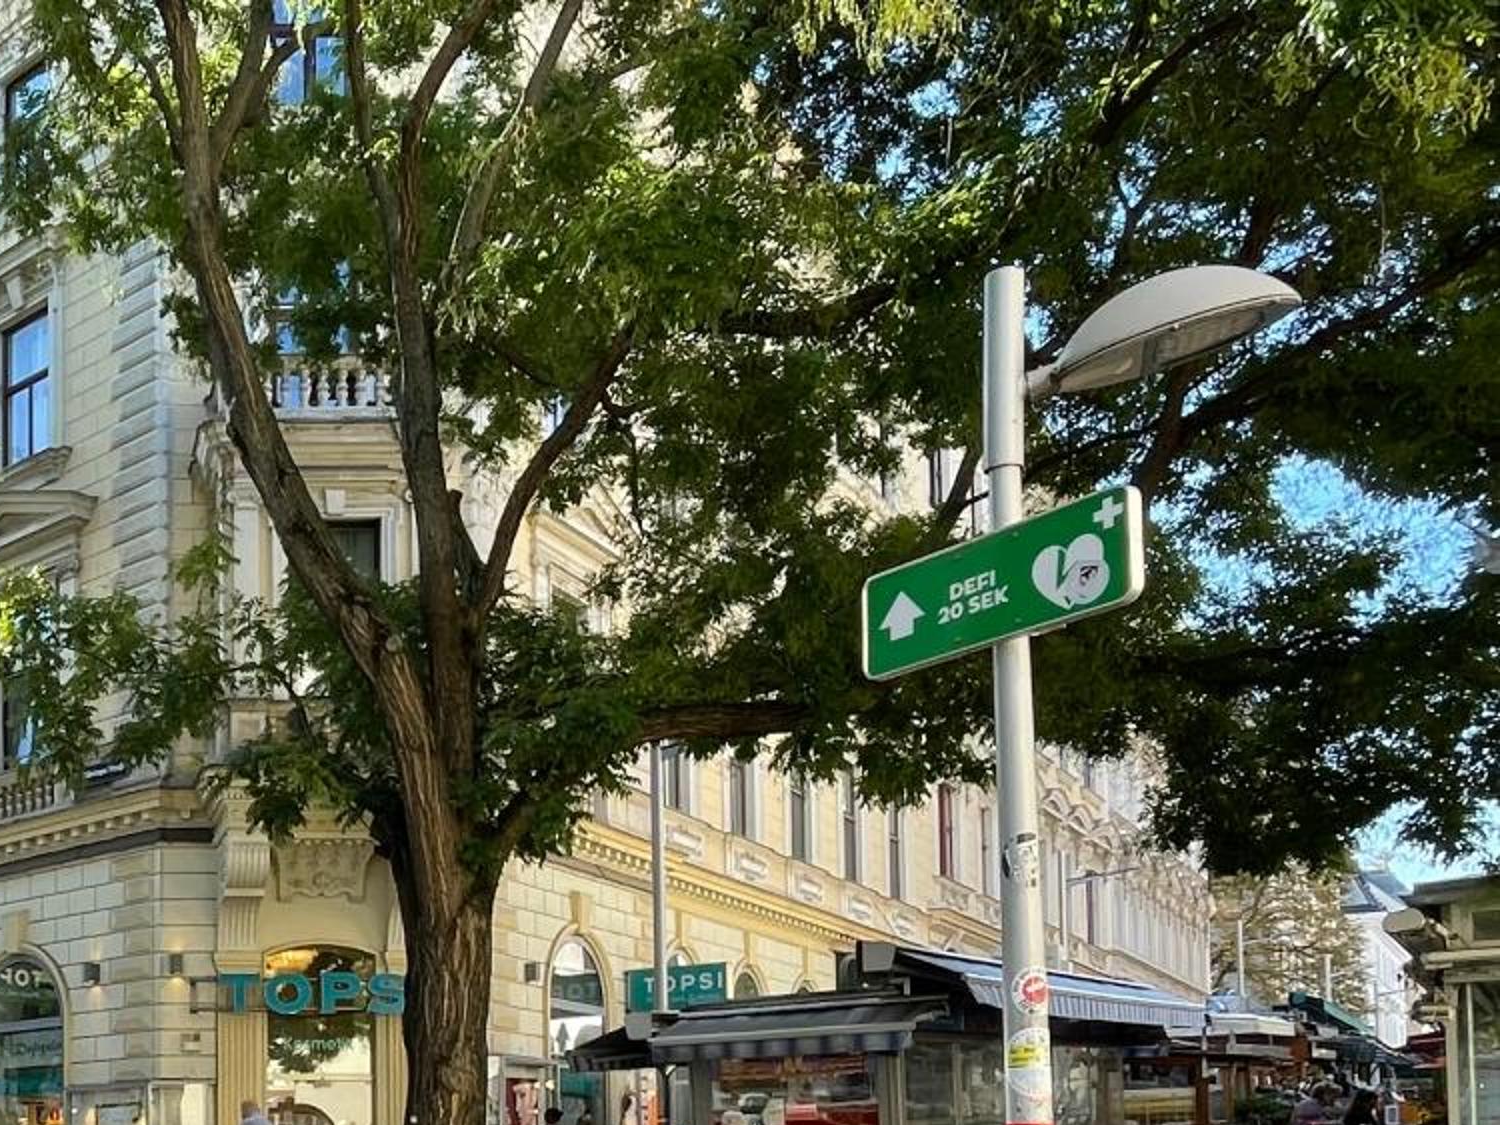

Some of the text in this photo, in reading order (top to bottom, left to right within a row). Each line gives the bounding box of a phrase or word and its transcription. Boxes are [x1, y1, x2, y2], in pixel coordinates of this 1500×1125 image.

[949, 570, 996, 601] DEFI
[938, 585, 1010, 624] 20 SEK
